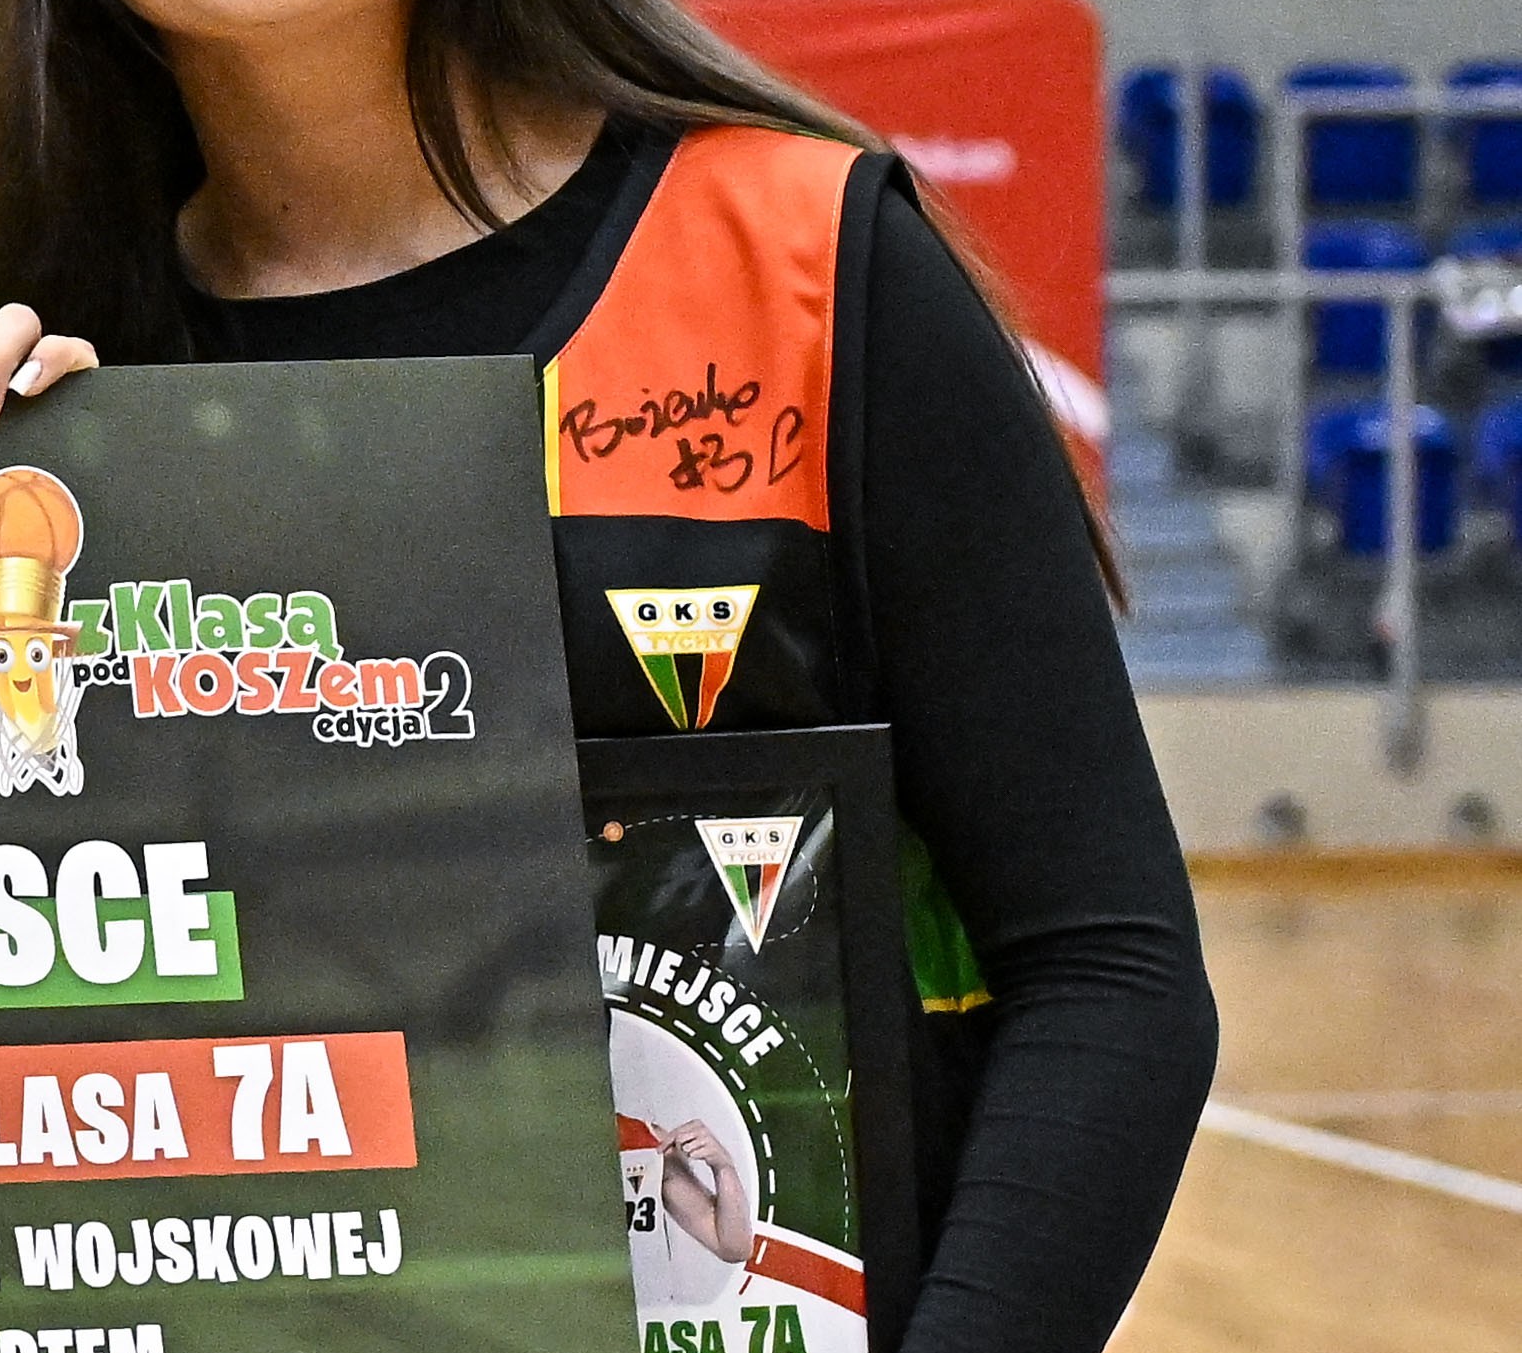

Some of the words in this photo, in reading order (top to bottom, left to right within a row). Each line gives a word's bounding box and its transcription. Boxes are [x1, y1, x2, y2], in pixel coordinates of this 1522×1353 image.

[638, 601, 731, 622] GKS
[72, 654, 131, 688] pod
[133, 650, 422, 716] KOSZem
[316, 707, 422, 744] edycja
[424, 652, 472, 736] 2
[721, 831, 781, 845] GKS
[728, 851, 778, 862] TYCHY
[596, 934, 785, 1067] MIEJSCE
[212, 1040, 354, 1161] 7A
[14, 1208, 403, 1291] WOJSKOWEJ
